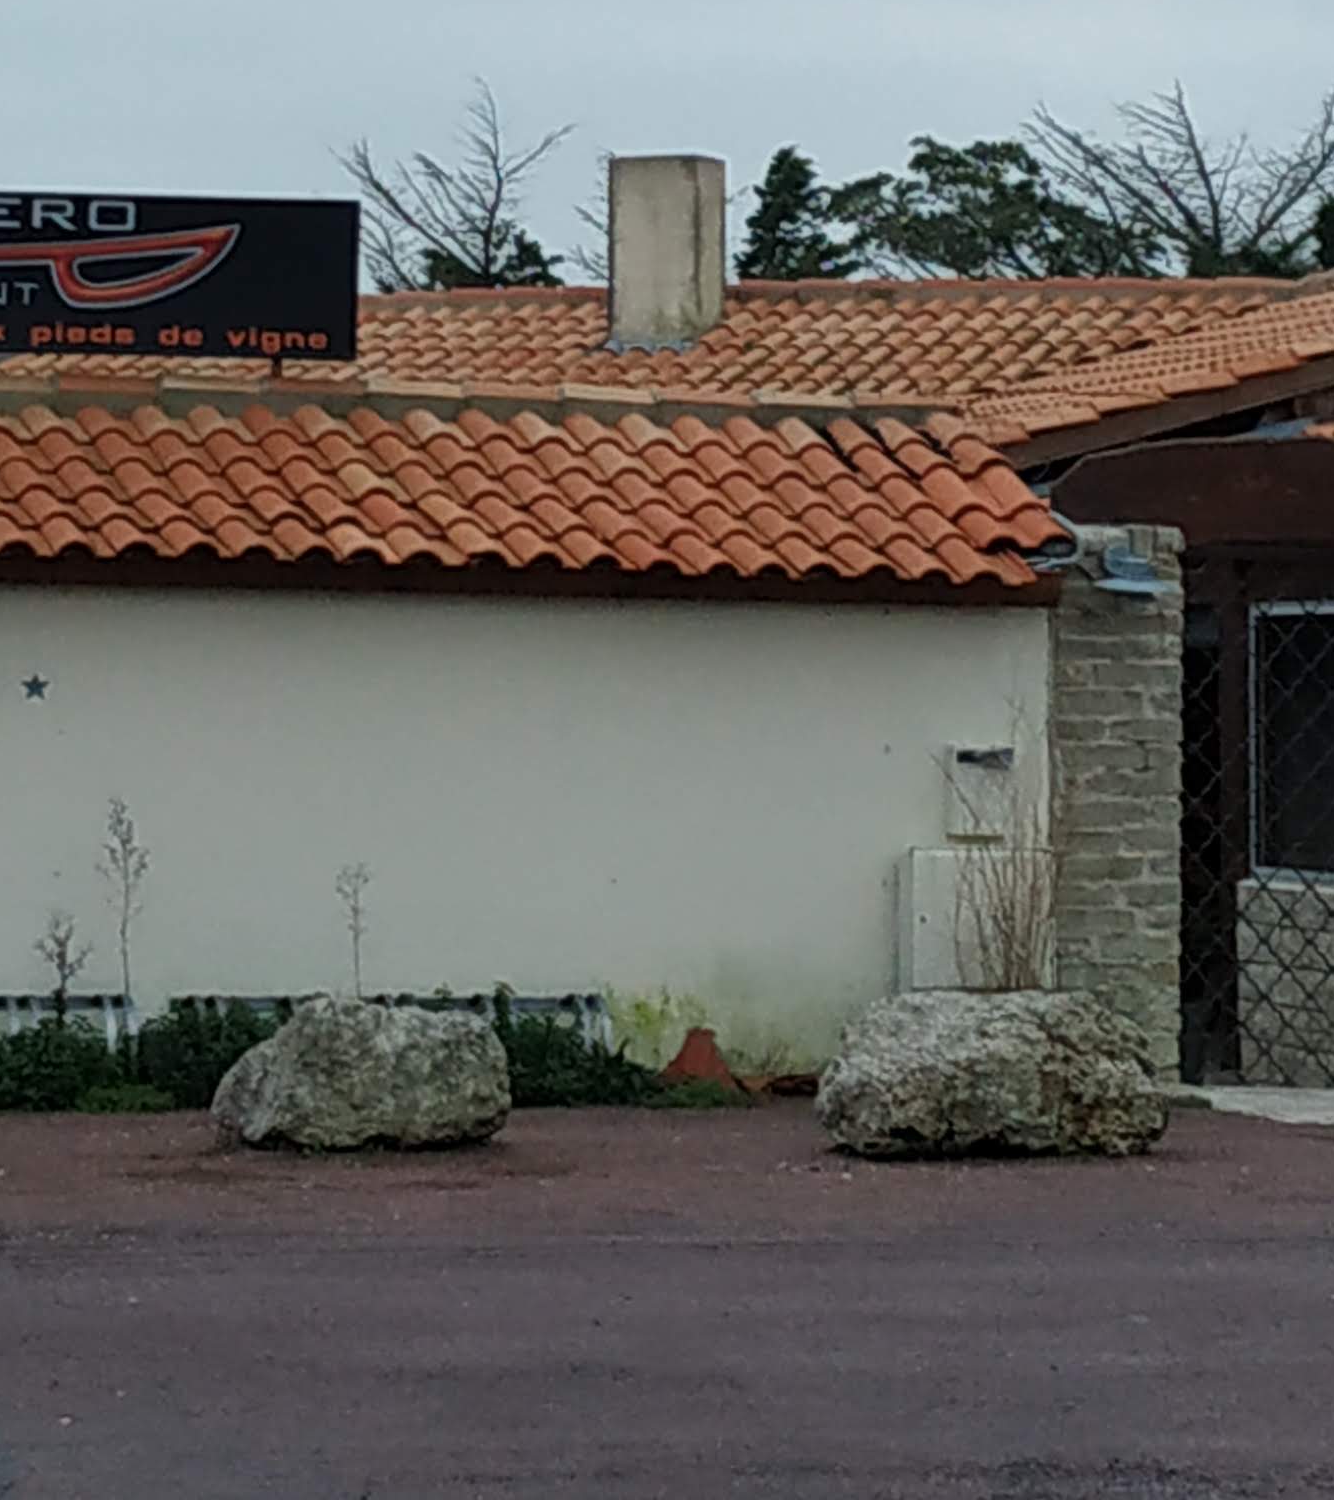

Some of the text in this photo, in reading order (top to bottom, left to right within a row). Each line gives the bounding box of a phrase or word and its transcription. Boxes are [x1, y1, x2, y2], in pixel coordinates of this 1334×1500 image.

[29, 323, 136, 348] pieds
[158, 325, 204, 347] de
[226, 328, 329, 354] vigne
